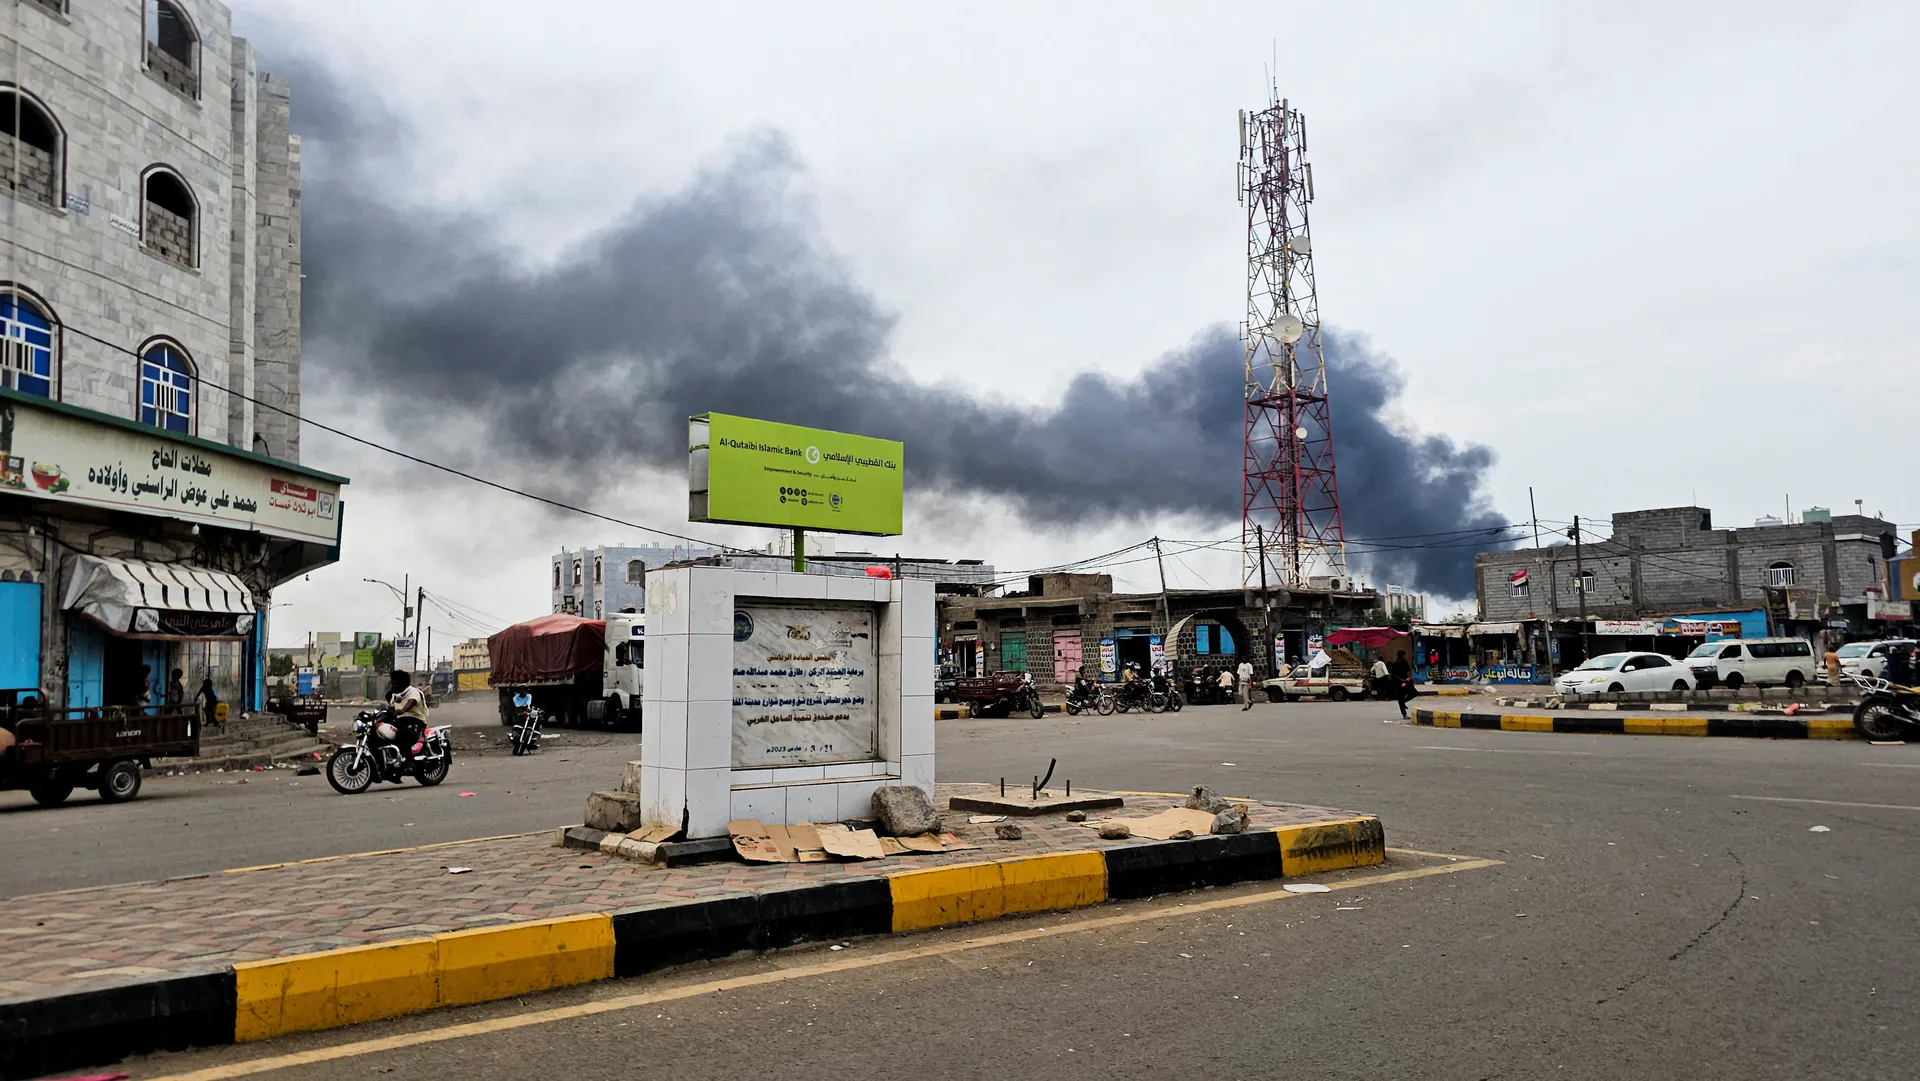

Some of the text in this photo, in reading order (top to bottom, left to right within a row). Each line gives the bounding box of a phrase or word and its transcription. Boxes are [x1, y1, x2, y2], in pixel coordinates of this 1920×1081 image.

[719, 438, 803, 456] Al-Qutaibi Islamic Bank
[152, 446, 212, 477] محلات الحاج
[823, 452, 896, 471] بنك القطيبي الإسلامي
[88, 460, 257, 515] محمد علي عوض الراسني وأولاده
[1507, 666, 1531, 682] بقالة
[852, 695, 864, 705] وضع
[747, 715, 769, 727] الغربي
[770, 714, 792, 724] الساحل
